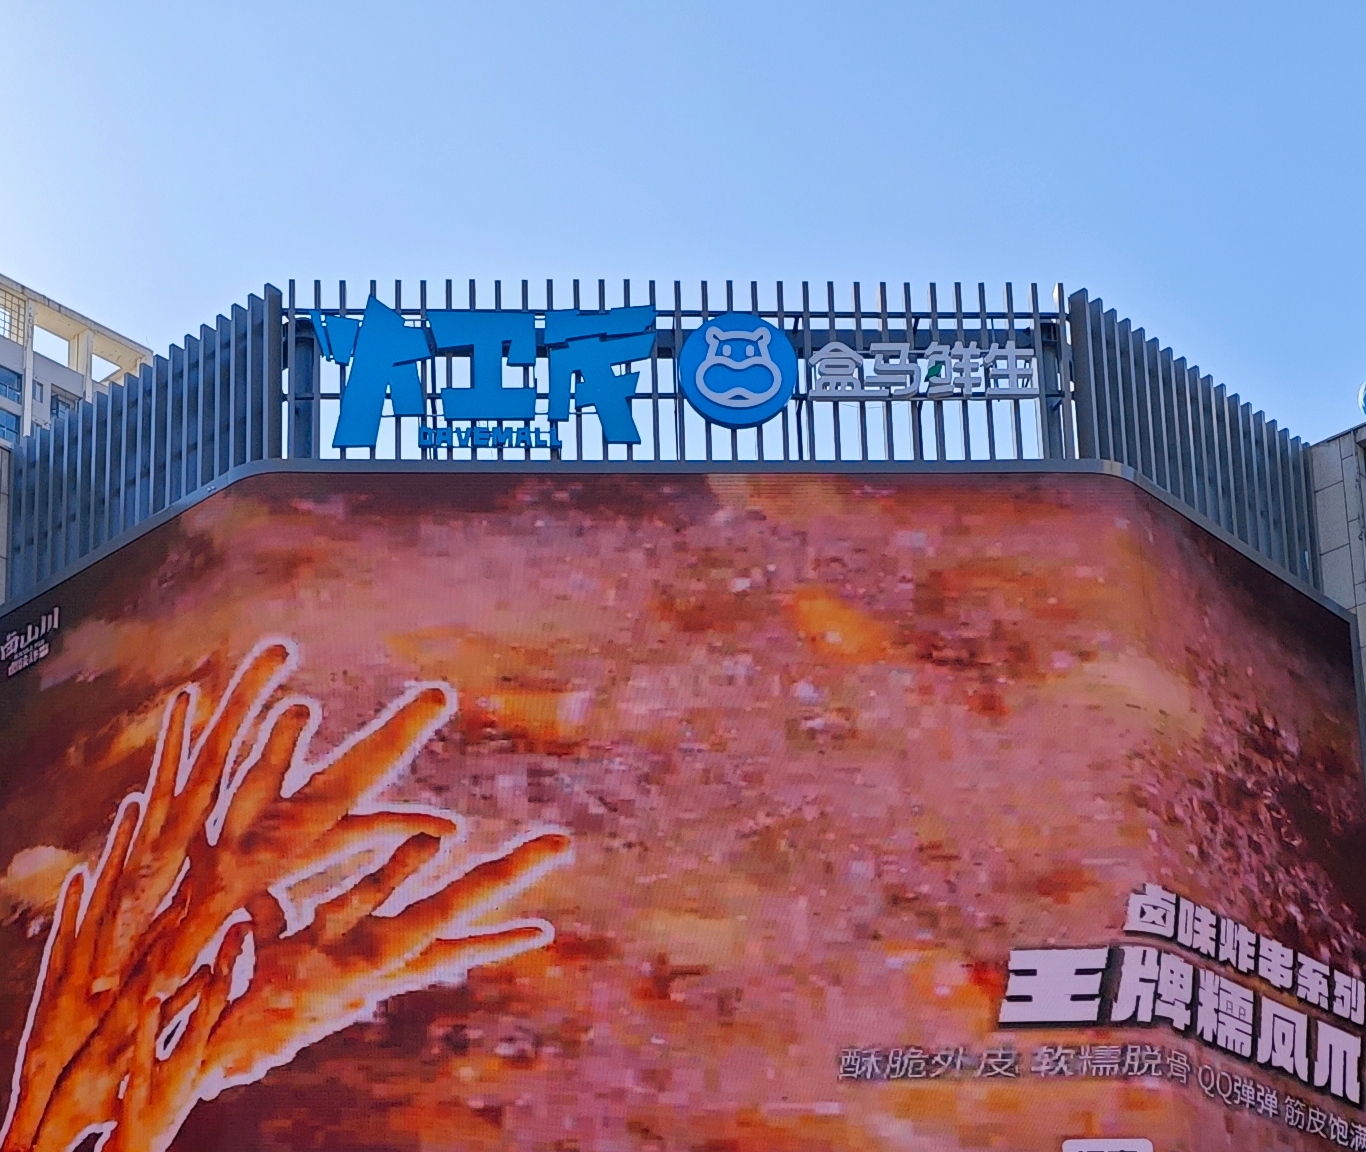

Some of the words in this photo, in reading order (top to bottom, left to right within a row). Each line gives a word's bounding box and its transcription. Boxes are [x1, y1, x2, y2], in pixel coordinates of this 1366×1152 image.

[809, 340, 1040, 400] 盒马鲜生
[418, 426, 563, 449] DAVEMALL
[1125, 884, 1365, 1025] 卤味炸串系列
[999, 946, 1362, 1103] 王牌糯凤爪
[838, 1046, 1020, 1080] 酥脆外皮
[1031, 1044, 1191, 1084] 软糯脱骨
[1197, 1064, 1279, 1118] QQ弹弹
